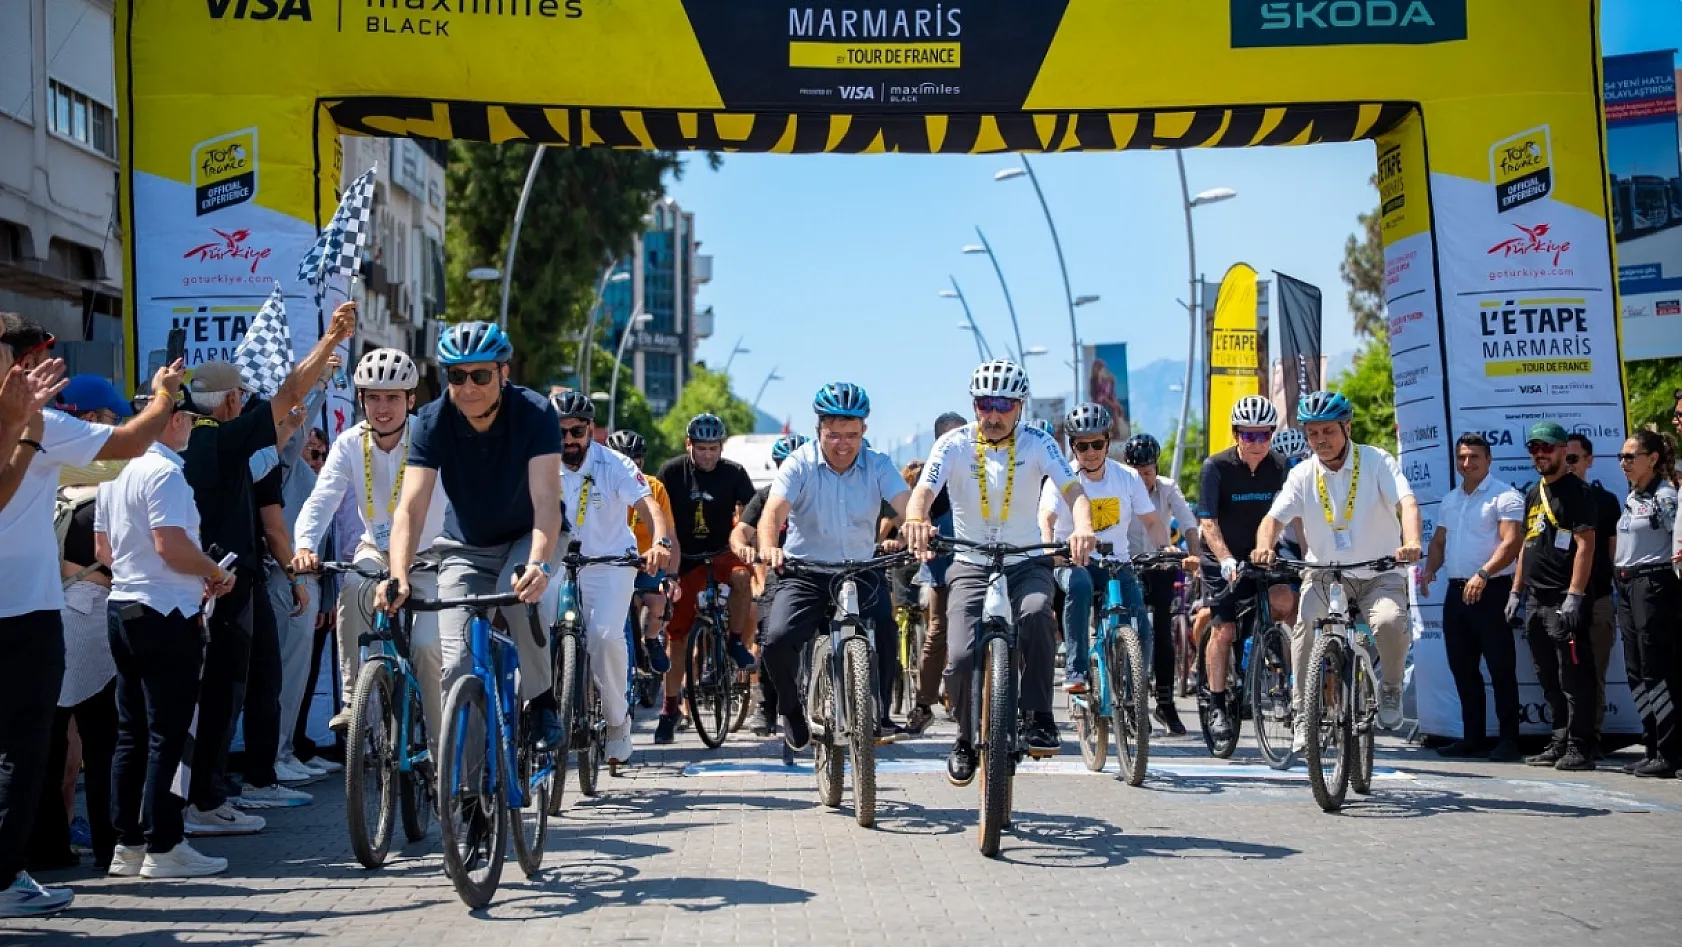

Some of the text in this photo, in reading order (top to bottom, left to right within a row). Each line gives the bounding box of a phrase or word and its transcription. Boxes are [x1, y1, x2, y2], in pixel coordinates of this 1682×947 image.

[366, 17, 450, 36] BLACK
[847, 48, 882, 64] TOUR
[885, 49, 901, 64] DE
[904, 48, 955, 64] FRANCE
[838, 86, 875, 100] VISA
[890, 83, 961, 95] maximiles
[208, 180, 242, 197] OFFICIAL
[1502, 182, 1547, 206] EXPERIENCE
[1507, 176, 1539, 195] OFFICIAL
[201, 187, 250, 209] EXPERIENCE
[183, 274, 273, 286] goturkiye.com
[1489, 267, 1574, 281] goturkiye.com
[1480, 300, 1588, 336] L'ÉTAPE
[1482, 334, 1592, 359] MARMARİS
[1522, 362, 1544, 374] TOUR
[1546, 362, 1556, 373] DE
[1558, 361, 1589, 373] FRANCE
[1518, 384, 1543, 395] VISA
[926, 462, 943, 484] VISA
